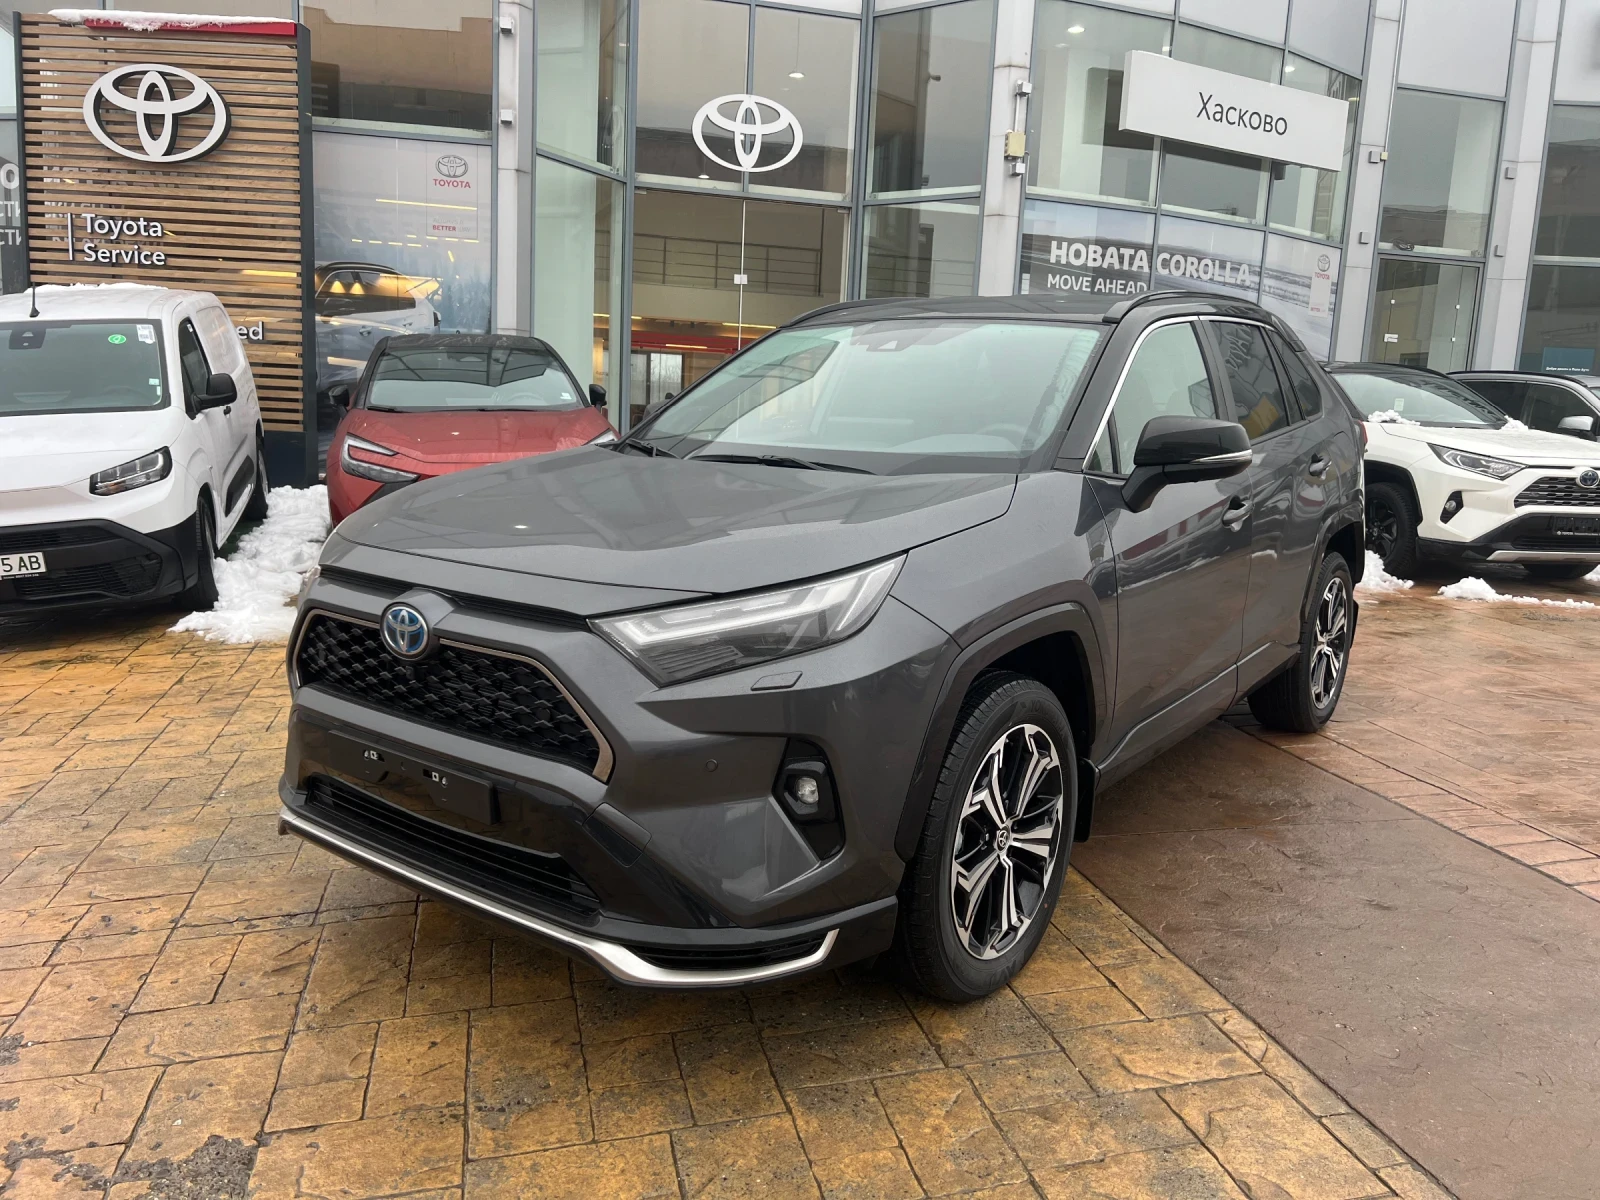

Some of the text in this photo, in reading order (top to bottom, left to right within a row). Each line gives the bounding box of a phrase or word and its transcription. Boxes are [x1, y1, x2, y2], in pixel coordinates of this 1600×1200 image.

[1196, 91, 1288, 136] Хасково
[433, 178, 471, 189] TOYOTA
[81, 213, 163, 240] Toyota
[432, 224, 457, 232] BETTER
[83, 243, 166, 265] Service
[1049, 240, 1251, 287] НОВАТА COROLLA
[1047, 273, 1148, 295] MOVE AHEAD
[1314, 271, 1330, 280] TOYOTA
[18, 555, 41, 571] AB
